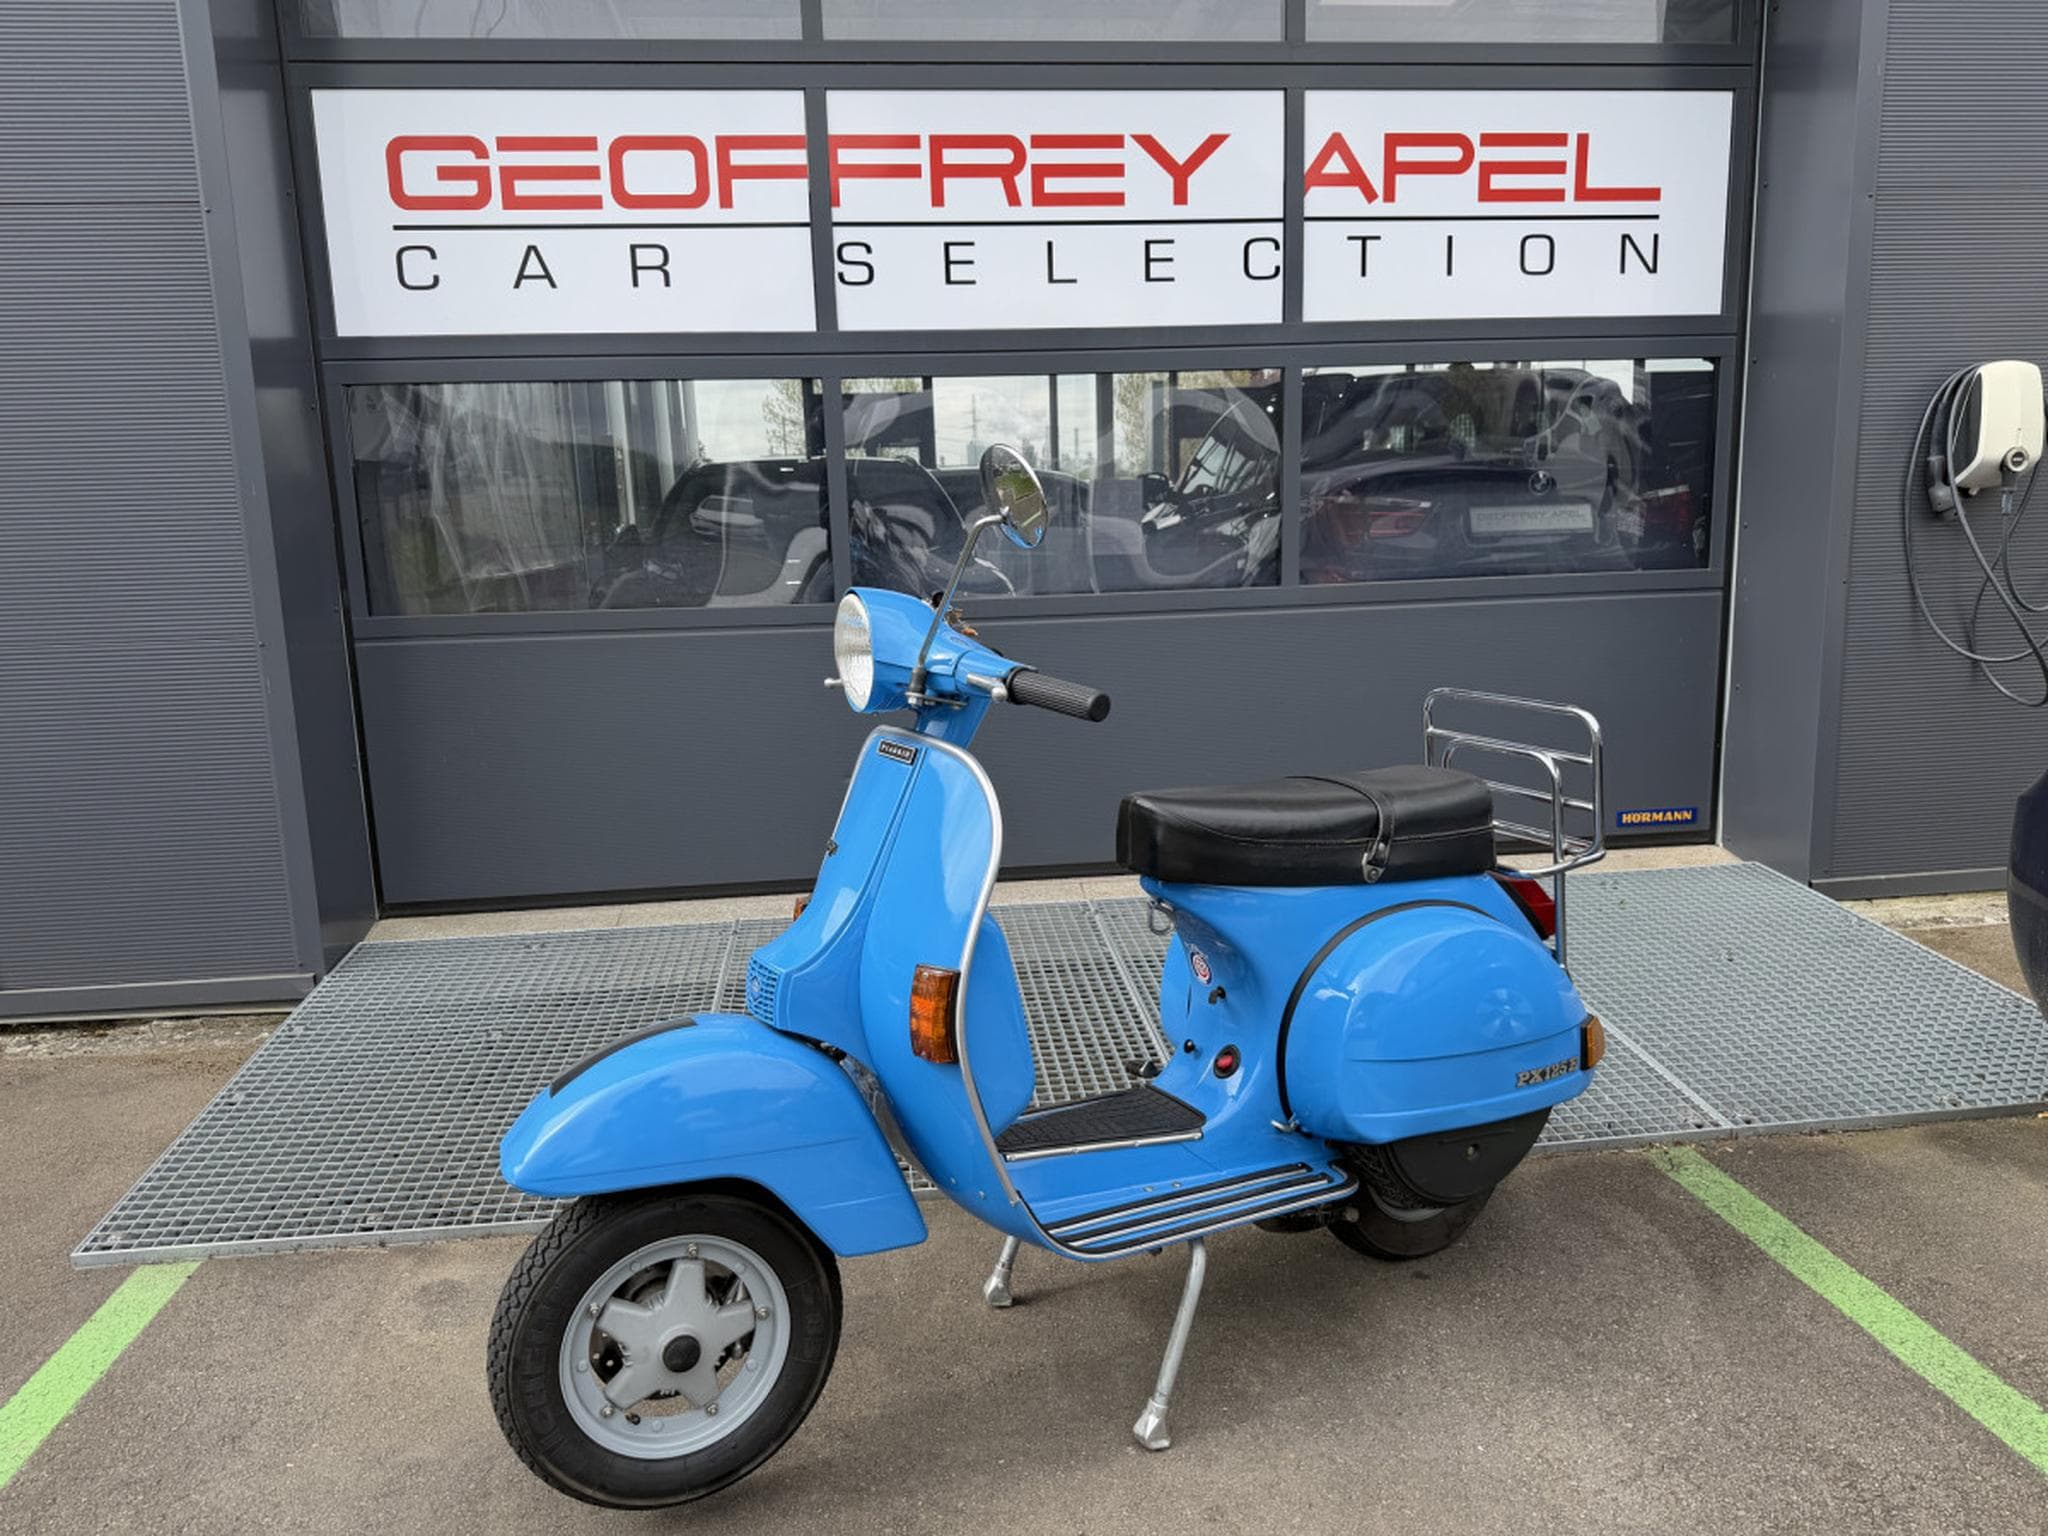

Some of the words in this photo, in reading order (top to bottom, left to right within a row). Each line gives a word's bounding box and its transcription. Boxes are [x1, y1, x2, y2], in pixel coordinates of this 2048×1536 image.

[386, 134, 1231, 210] GEOFFREY
[1305, 132, 1661, 203] APEL
[395, 243, 672, 291] CAR
[836, 233, 1660, 287] SELECTION
